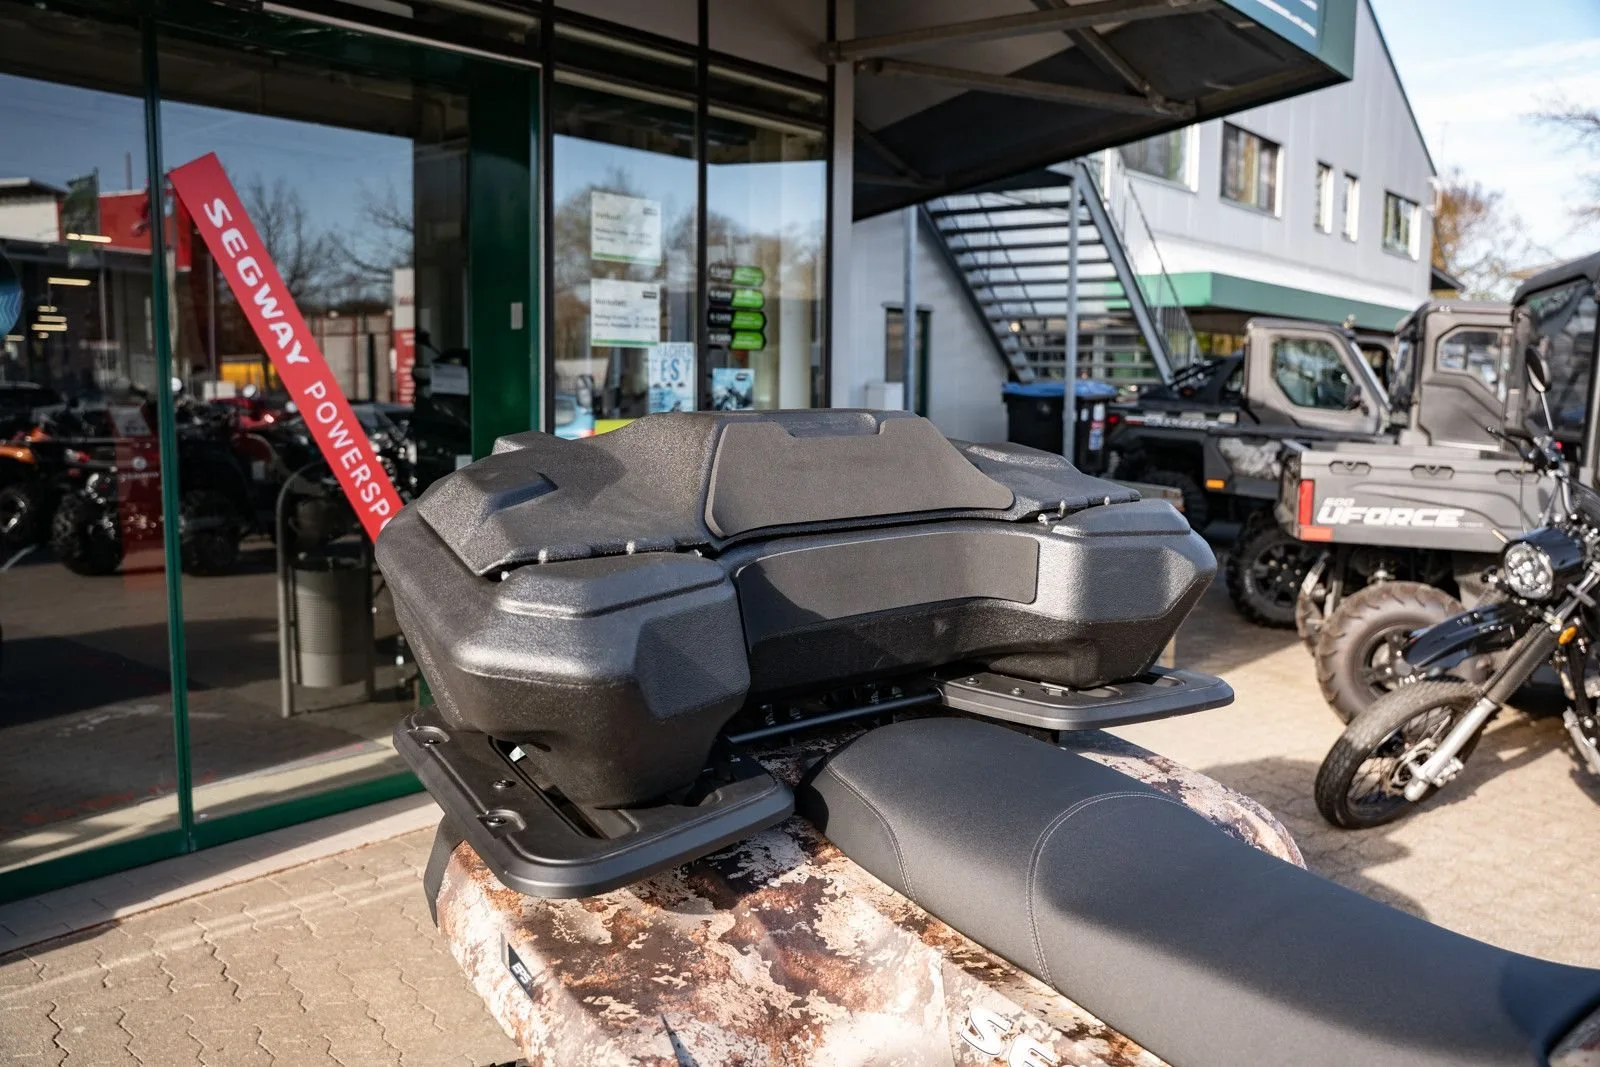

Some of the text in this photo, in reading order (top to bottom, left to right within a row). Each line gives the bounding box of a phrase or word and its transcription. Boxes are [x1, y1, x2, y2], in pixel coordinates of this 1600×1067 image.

[203, 198, 392, 532] SEGWAY POWERSP
[1317, 504, 1465, 528] UFORCE
